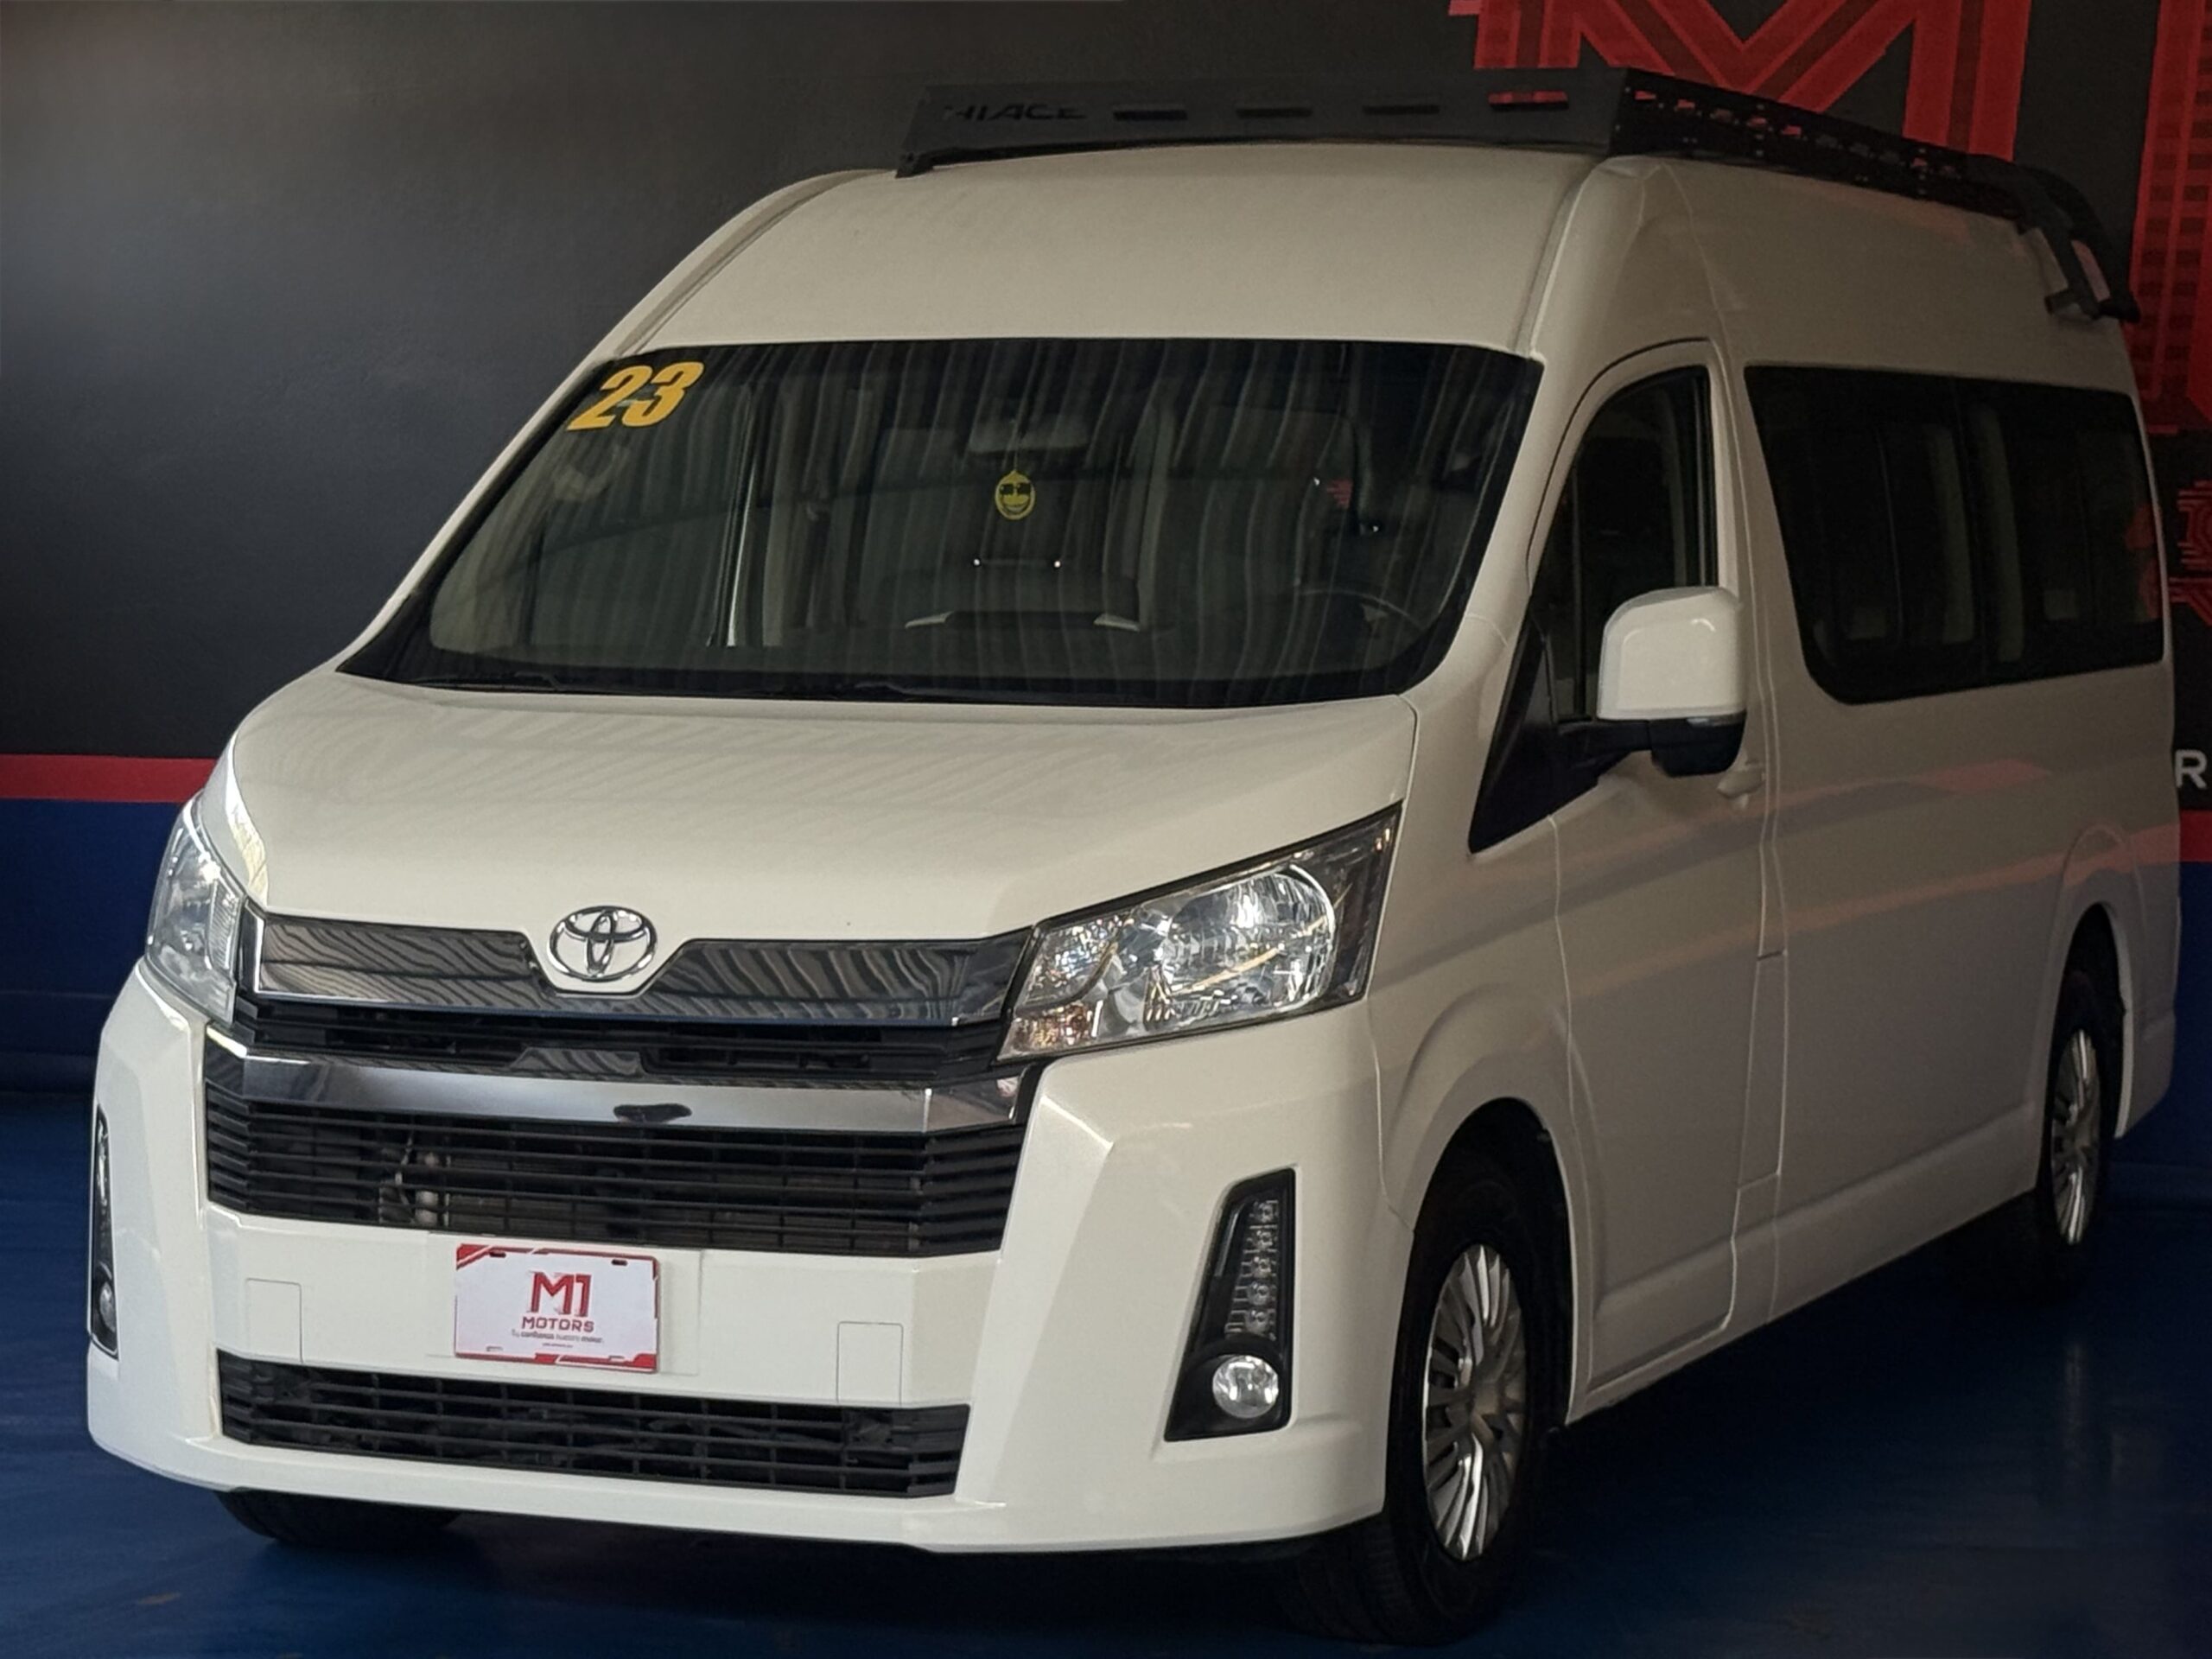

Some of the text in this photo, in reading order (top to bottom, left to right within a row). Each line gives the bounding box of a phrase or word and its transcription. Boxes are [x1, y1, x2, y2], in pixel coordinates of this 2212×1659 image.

[566, 360, 705, 431] 23
[528, 1271, 592, 1318] M1
[521, 1316, 595, 1333] MOTORS
